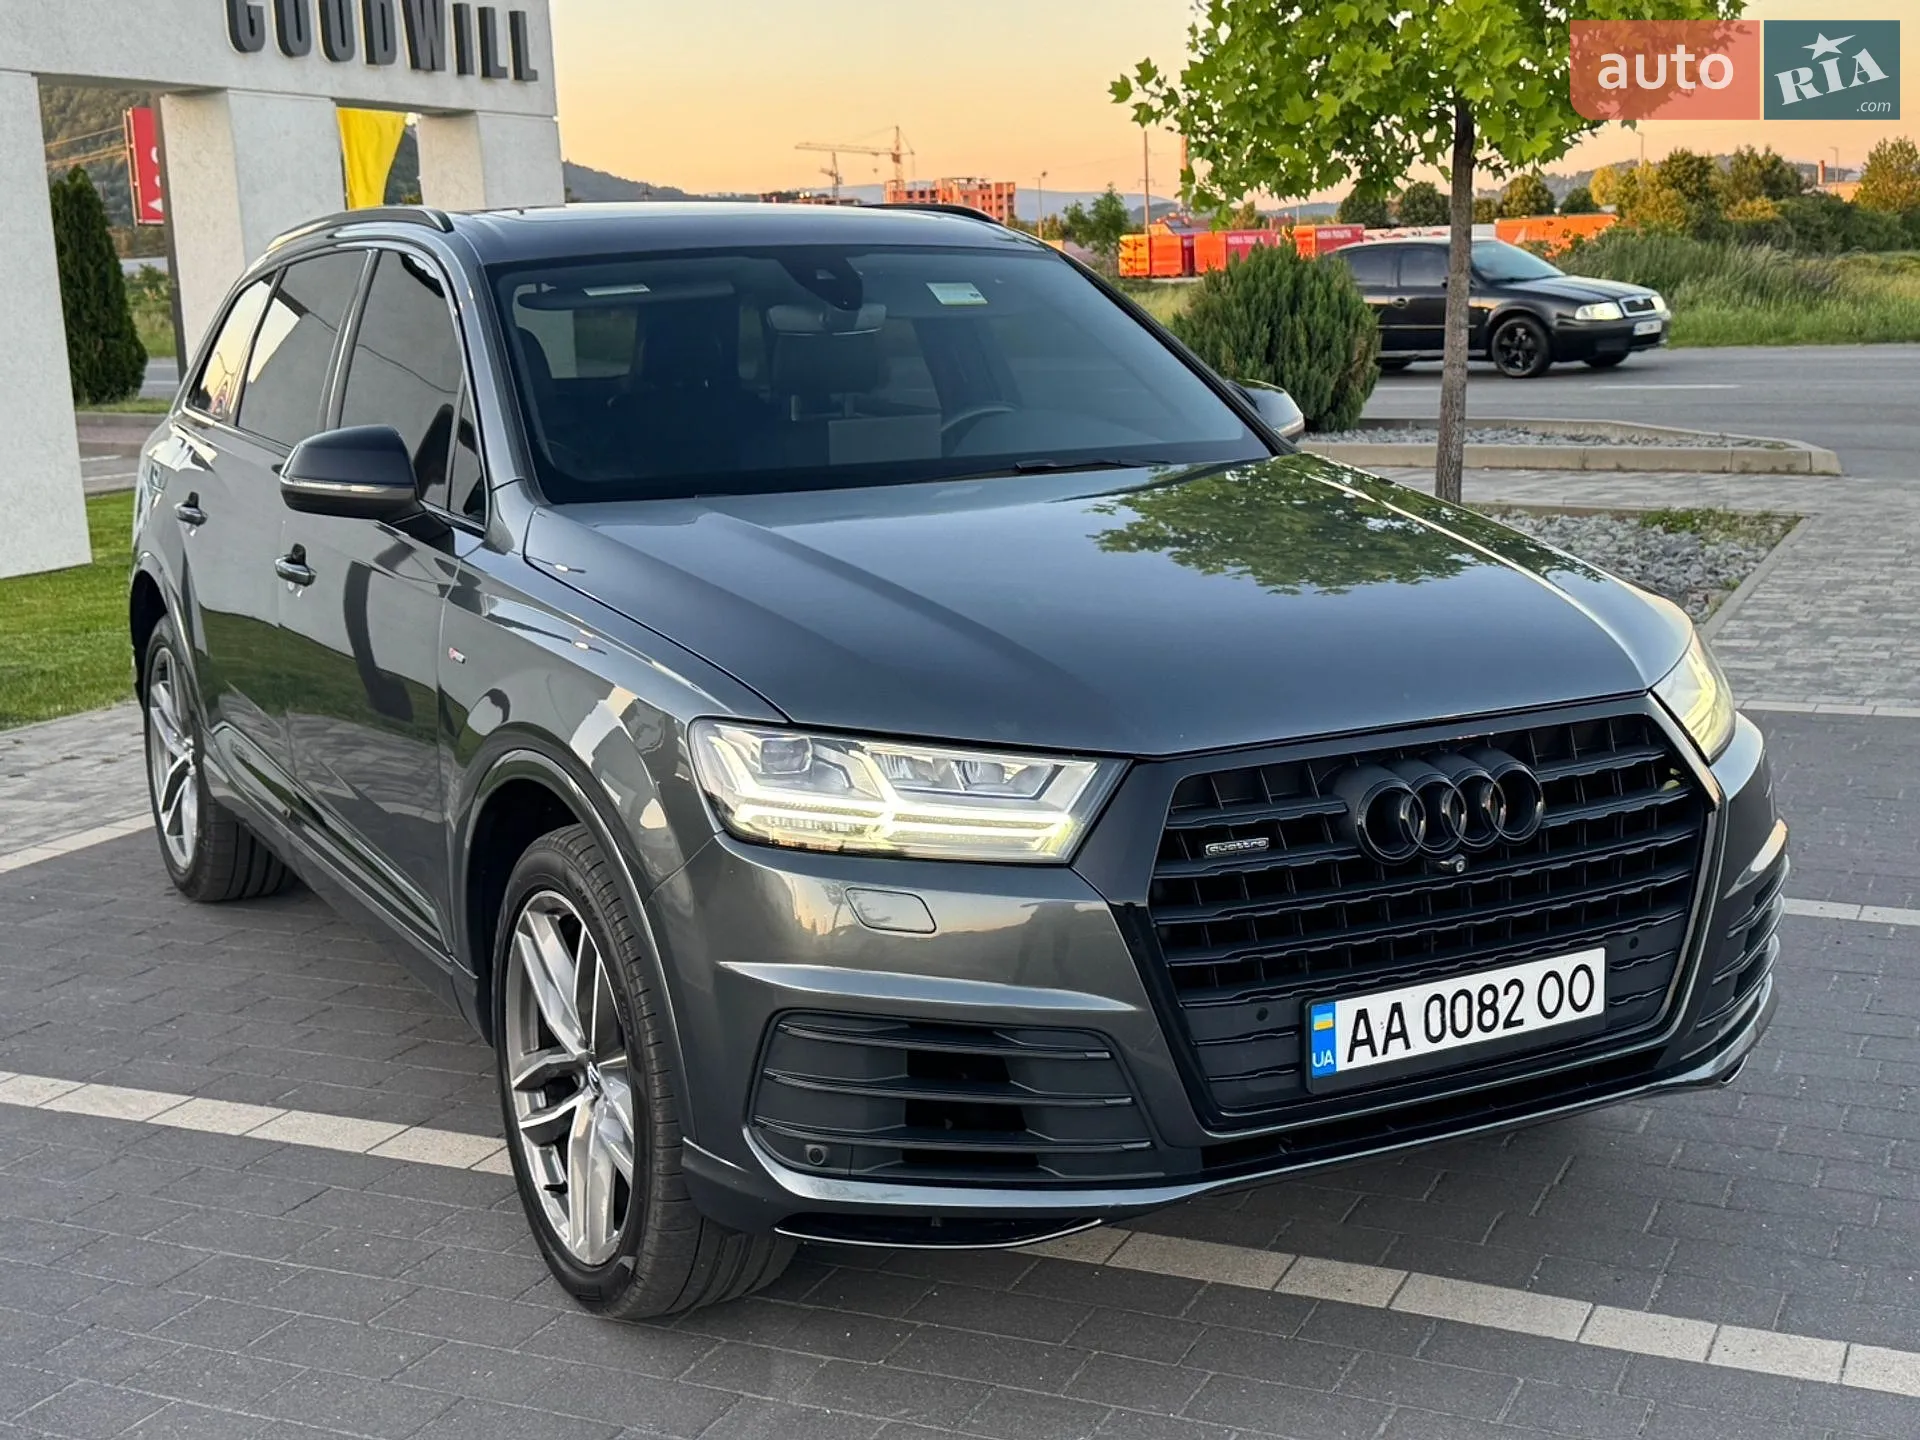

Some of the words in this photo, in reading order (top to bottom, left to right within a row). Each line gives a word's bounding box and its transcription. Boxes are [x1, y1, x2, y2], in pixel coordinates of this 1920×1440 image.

[1207, 839, 1267, 855] quattro
[1347, 1001, 1411, 1063] AA
[1424, 978, 1525, 1044] 0082
[1312, 1050, 1334, 1067] UA
